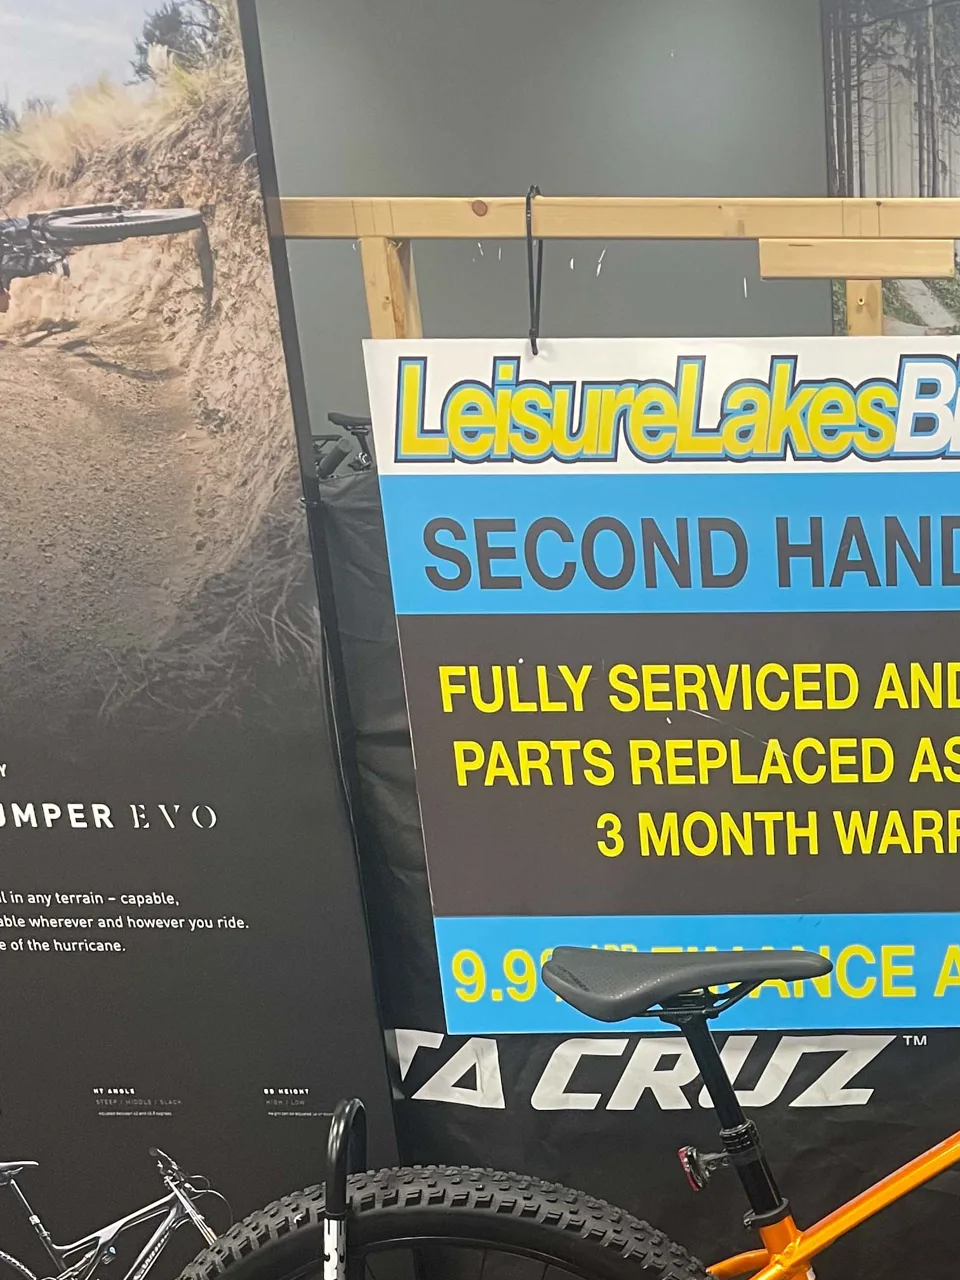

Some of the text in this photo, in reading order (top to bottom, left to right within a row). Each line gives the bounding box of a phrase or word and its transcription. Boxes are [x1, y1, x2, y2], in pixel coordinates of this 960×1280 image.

[423, 516, 749, 591] SECOND
[438, 663, 592, 713] FULLY
[608, 661, 859, 712] SERVICED
[453, 738, 615, 787] PARTS
[629, 736, 894, 785] REPLACED
[0, 802, 217, 829] MPER EVO
[596, 812, 625, 858] 3
[638, 810, 819, 857] MONTH
[9, 890, 24, 904] in
[27, 894, 52, 908] any
[55, 891, 104, 905] terrain
[120, 891, 180, 908] capable,
[28, 914, 94, 928] wherever
[97, 915, 123, 929] and
[126, 915, 186, 929] however
[188, 918, 214, 932] you
[217, 915, 249, 929] ride.
[10, 938, 24, 951] of
[27, 938, 51, 951] the
[53, 938, 126, 952] hurricane.
[452, 948, 564, 1002] 9.9
[531, 1034, 898, 1111] CRUZ
[903, 1035, 927, 1046] TM
